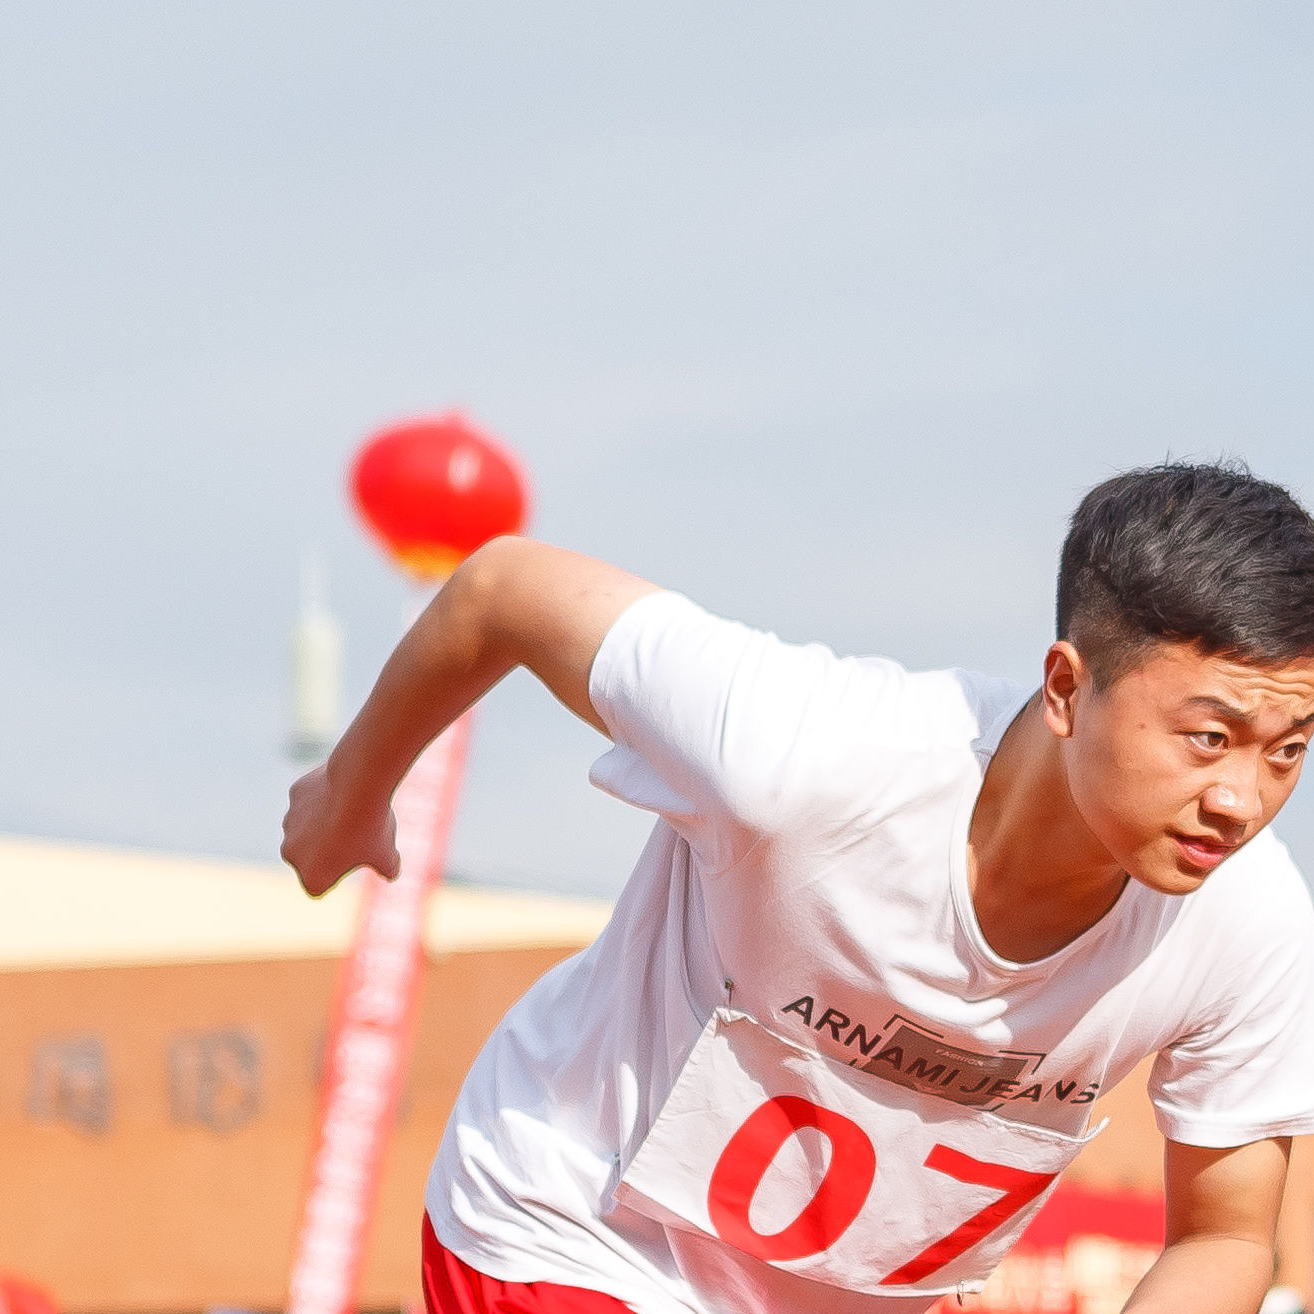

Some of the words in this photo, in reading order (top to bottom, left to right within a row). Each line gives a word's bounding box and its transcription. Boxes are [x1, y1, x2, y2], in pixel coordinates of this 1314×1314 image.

[782, 995, 961, 1087] ARNAMI
[960, 1076, 1100, 1104] JEANS
[707, 1094, 1060, 1285] 07
